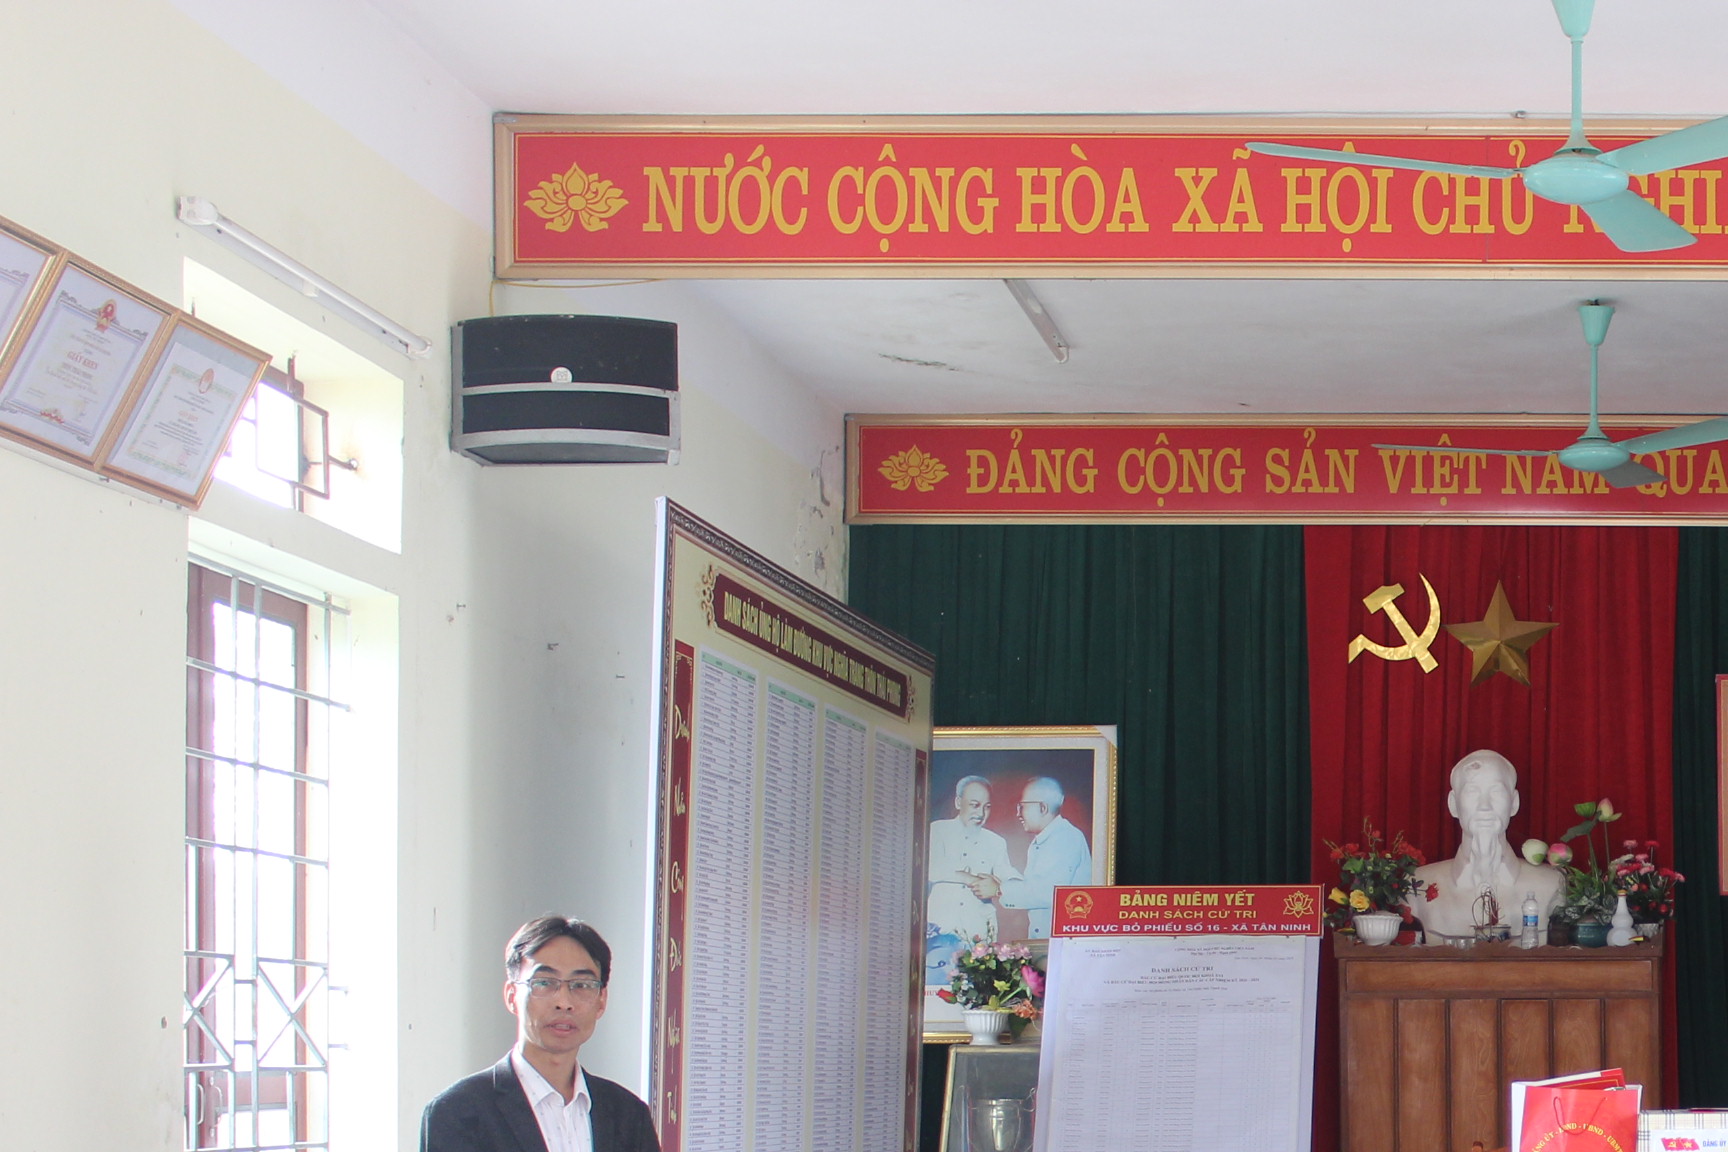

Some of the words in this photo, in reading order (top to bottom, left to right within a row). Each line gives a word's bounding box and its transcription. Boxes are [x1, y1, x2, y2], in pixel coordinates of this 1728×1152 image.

[642, 152, 810, 236] NƯỚC
[827, 144, 999, 254] CỘNG
[1015, 144, 1149, 235] HÒA
[1171, 145, 1263, 235] XÃ
[1280, 140, 1392, 254] HỘI
[1412, 139, 1534, 236] CHỦ
[965, 427, 1098, 495] ĐẢNG
[1117, 432, 1247, 508] CỘNG
[1265, 427, 1359, 495] SẢN
[1378, 432, 1487, 507] VIỆT
[1501, 450, 1610, 495] NAM
[1119, 889, 1168, 907] BẢNG
[1172, 890, 1218, 907] NIÊM
[1224, 888, 1256, 906] YẾT
[1118, 910, 1160, 920] DANH
[1162, 907, 1204, 920] SÁCH
[1234, 910, 1258, 919] TRI
[1062, 923, 1090, 933] KHU
[1092, 922, 1119, 935] VỰC
[1122, 921, 1142, 933] BỎ
[1144, 920, 1182, 932] PHIẾU
[1184, 919, 1204, 932] SỐ
[1206, 923, 1221, 932] 16
[1231, 920, 1249, 932] XÃ
[1250, 920, 1278, 932] TÂN
[1280, 922, 1312, 932] NINH
